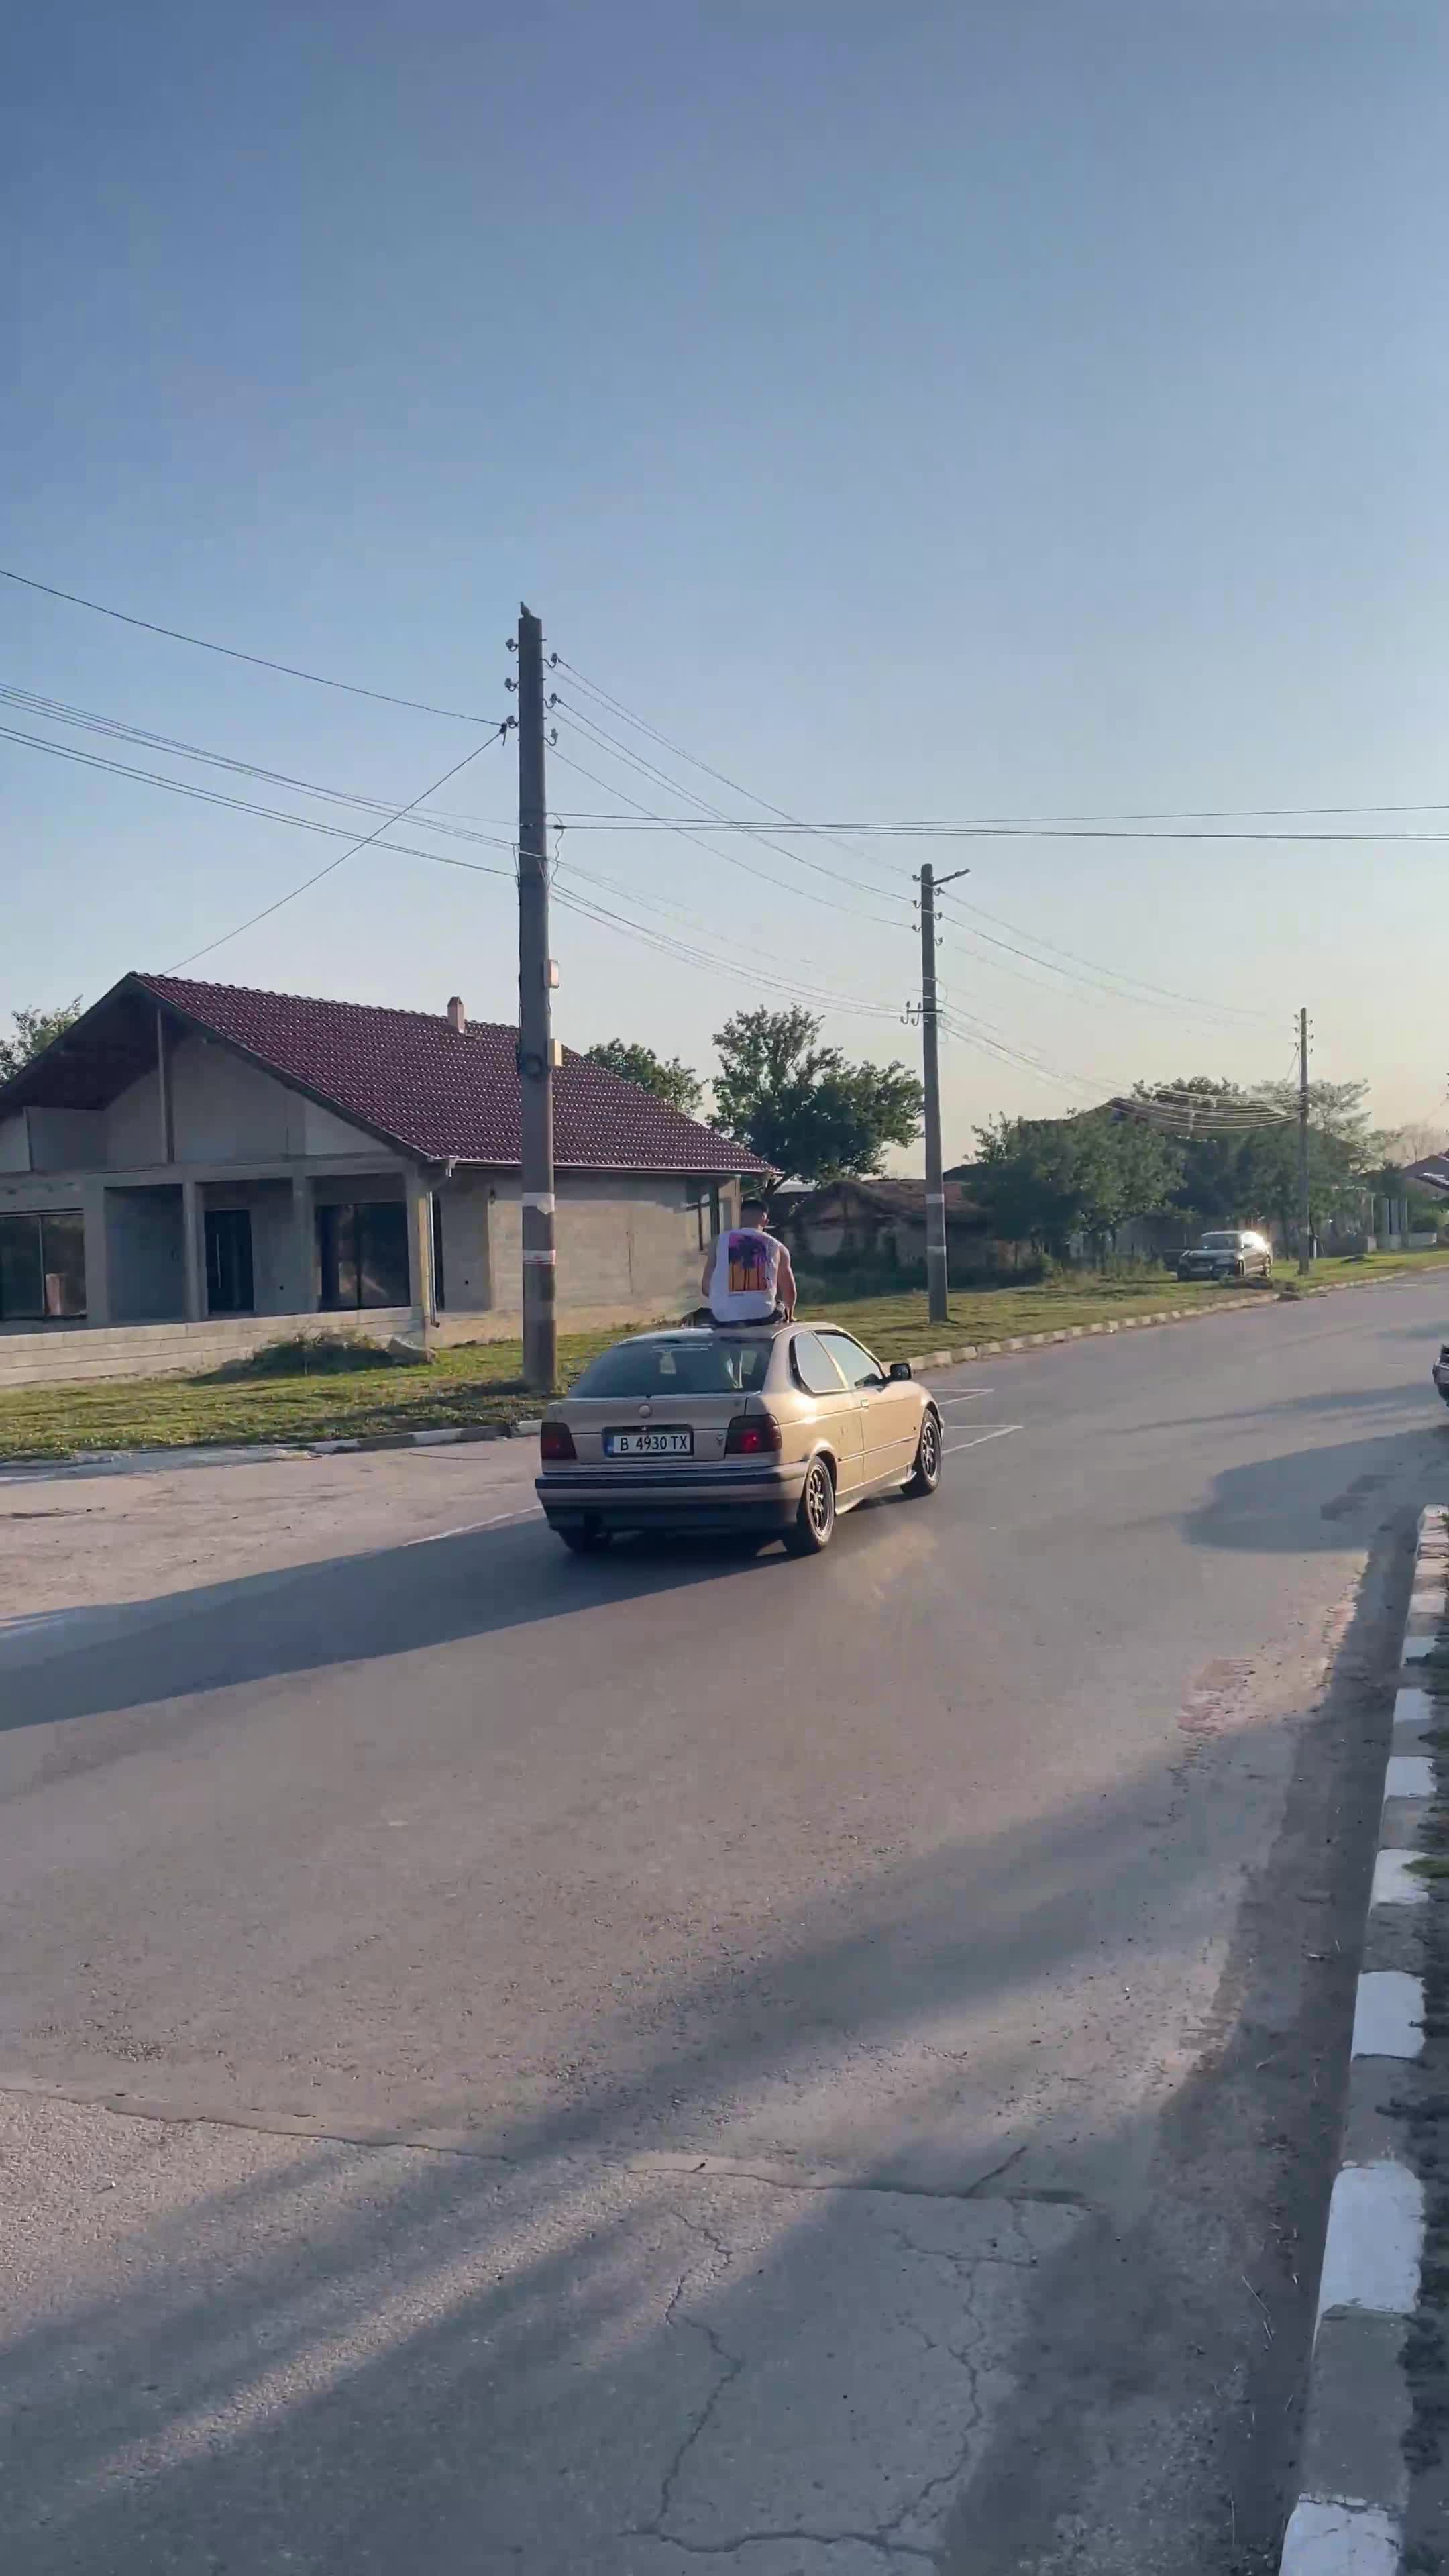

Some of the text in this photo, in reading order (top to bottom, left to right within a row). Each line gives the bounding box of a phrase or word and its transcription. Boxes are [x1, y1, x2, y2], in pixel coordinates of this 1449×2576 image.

[620, 1436, 688, 1451] B 4930 TX
